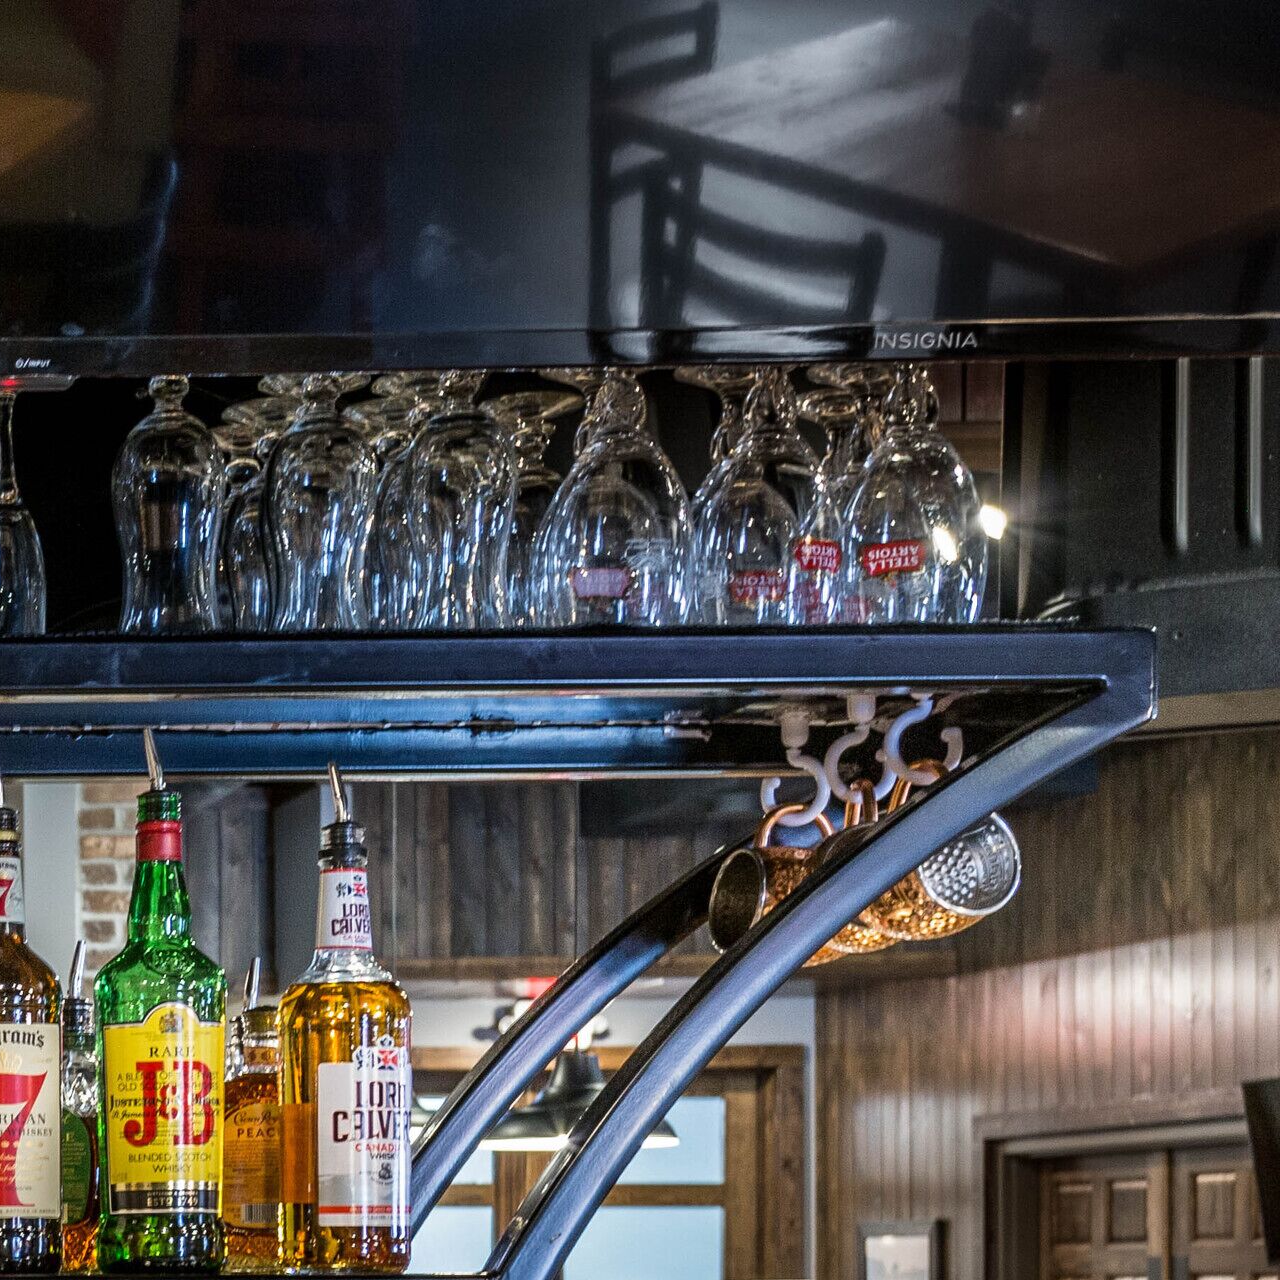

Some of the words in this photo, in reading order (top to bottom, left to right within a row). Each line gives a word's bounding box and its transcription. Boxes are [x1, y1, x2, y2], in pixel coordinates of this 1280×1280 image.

[874, 331, 978, 349] INSIGNIA
[867, 545, 920, 561] ARTOIS
[869, 554, 920, 576] STELLA
[149, 1047, 195, 1058] RARE
[123, 1061, 215, 1147] J&B
[128, 1154, 171, 1163] BLENDED
[175, 1153, 212, 1163] SCOTCH
[152, 1164, 192, 1174] WHISKY
